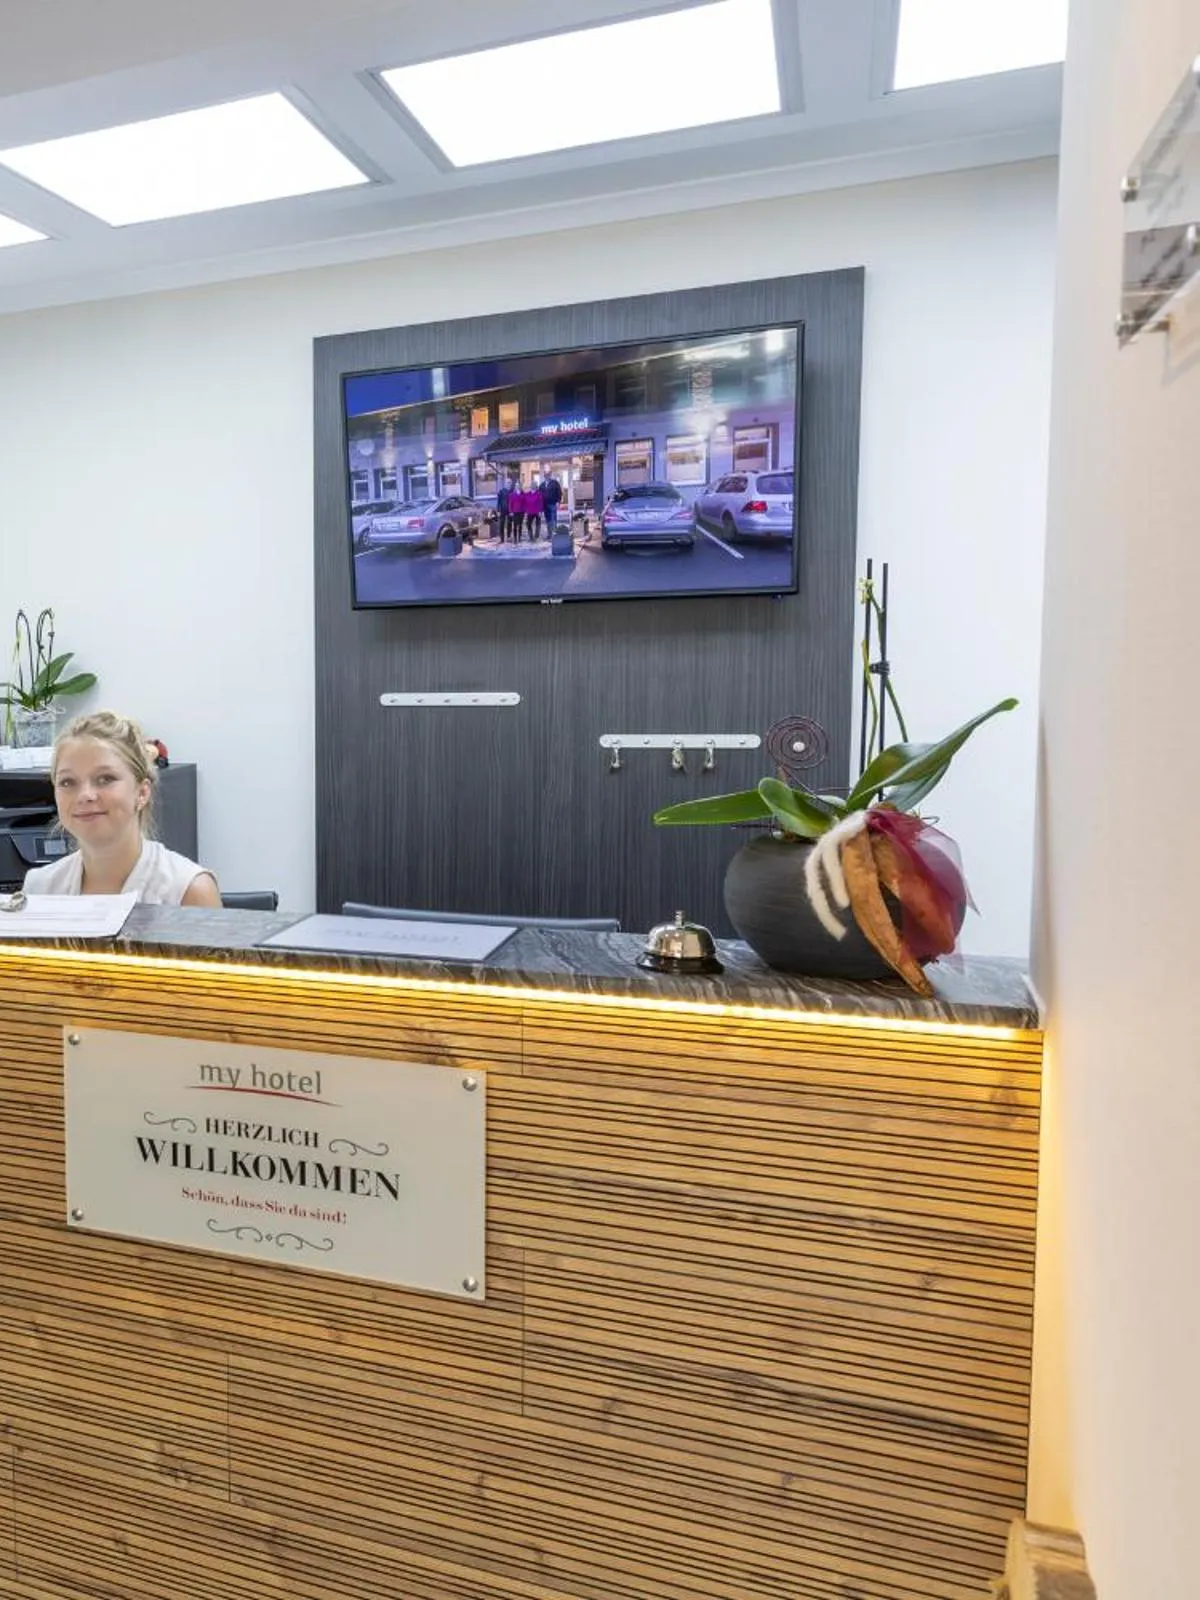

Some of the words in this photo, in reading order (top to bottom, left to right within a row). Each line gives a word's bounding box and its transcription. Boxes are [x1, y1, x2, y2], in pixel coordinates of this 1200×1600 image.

[542, 425, 558, 434] my
[560, 418, 588, 430] hotel
[200, 1064, 241, 1089] my
[252, 1063, 322, 1095] hotel
[205, 1117, 320, 1148] HERZLICH
[135, 1136, 400, 1201] WILLKOMMEN
[181, 1187, 228, 1206] Schön,
[231, 1195, 263, 1210] dass
[265, 1199, 286, 1214] Sie
[289, 1203, 307, 1218] da
[309, 1207, 347, 1224] sind!
